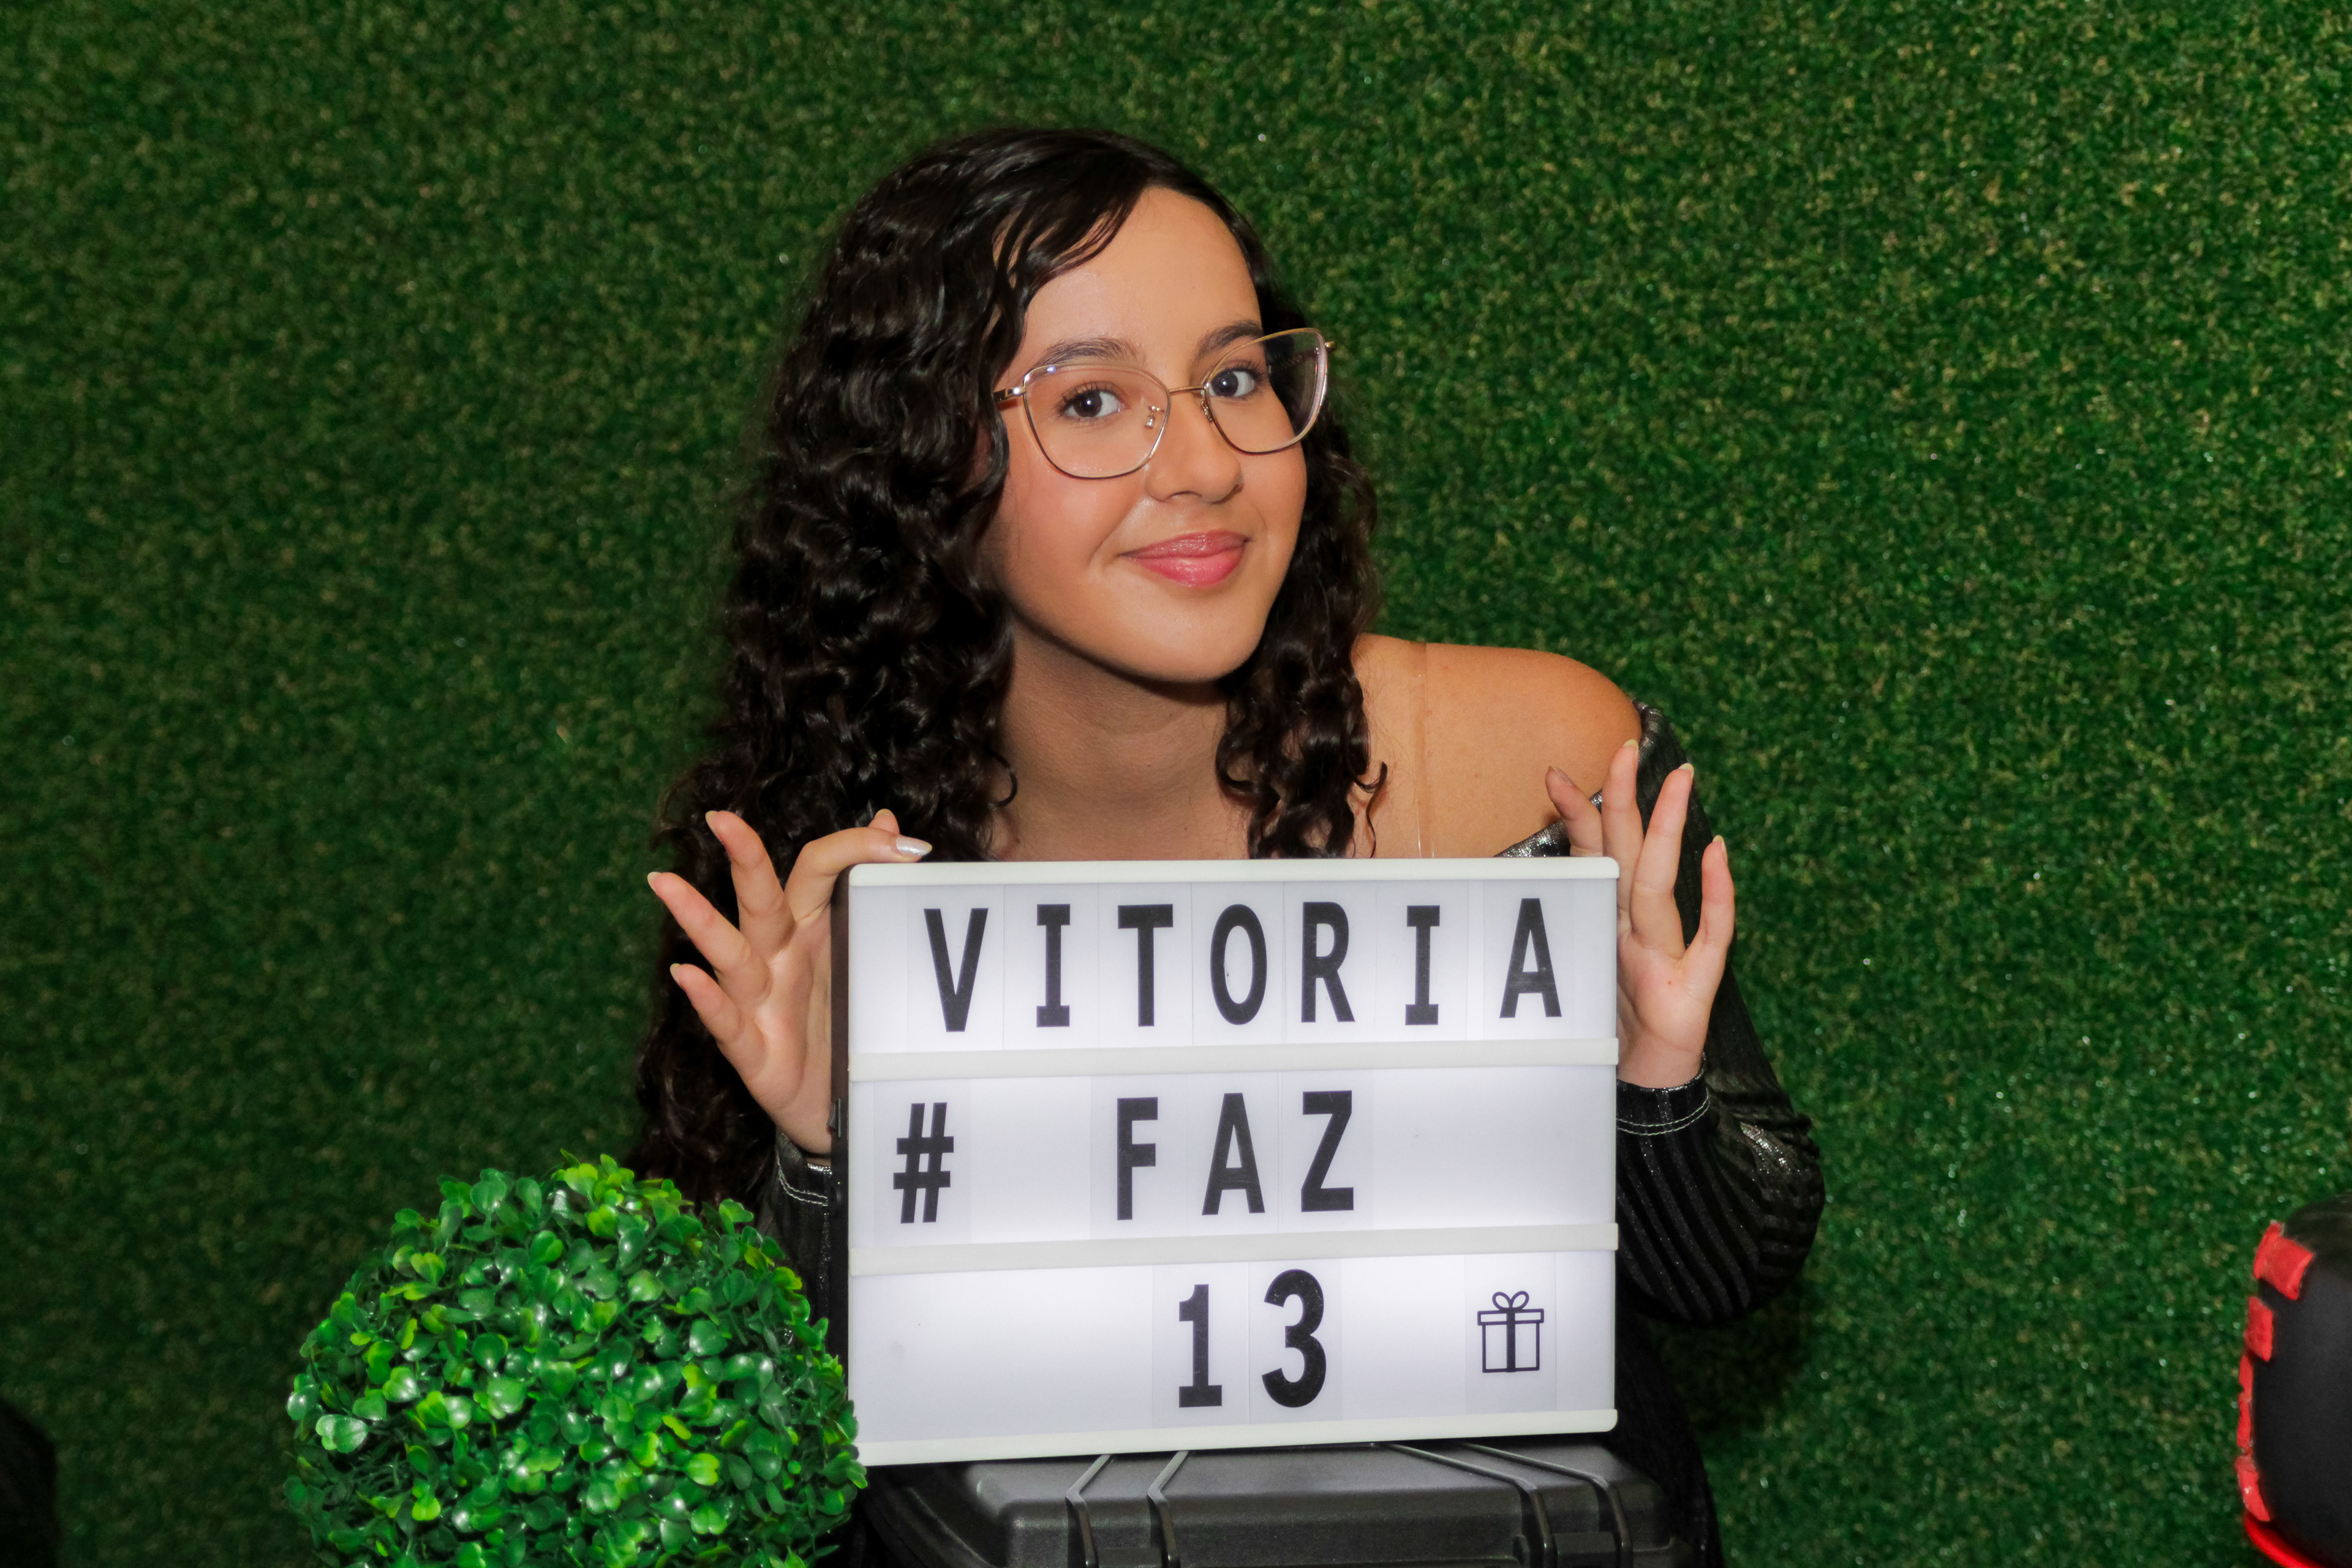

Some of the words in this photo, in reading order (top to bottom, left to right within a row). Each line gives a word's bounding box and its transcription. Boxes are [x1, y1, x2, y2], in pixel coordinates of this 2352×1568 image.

[923, 897, 1562, 1033] VITORIA
[892, 1102, 955, 1224] #
[1117, 1090, 1355, 1221] FAZ
[1178, 1268, 1327, 1409] 13
